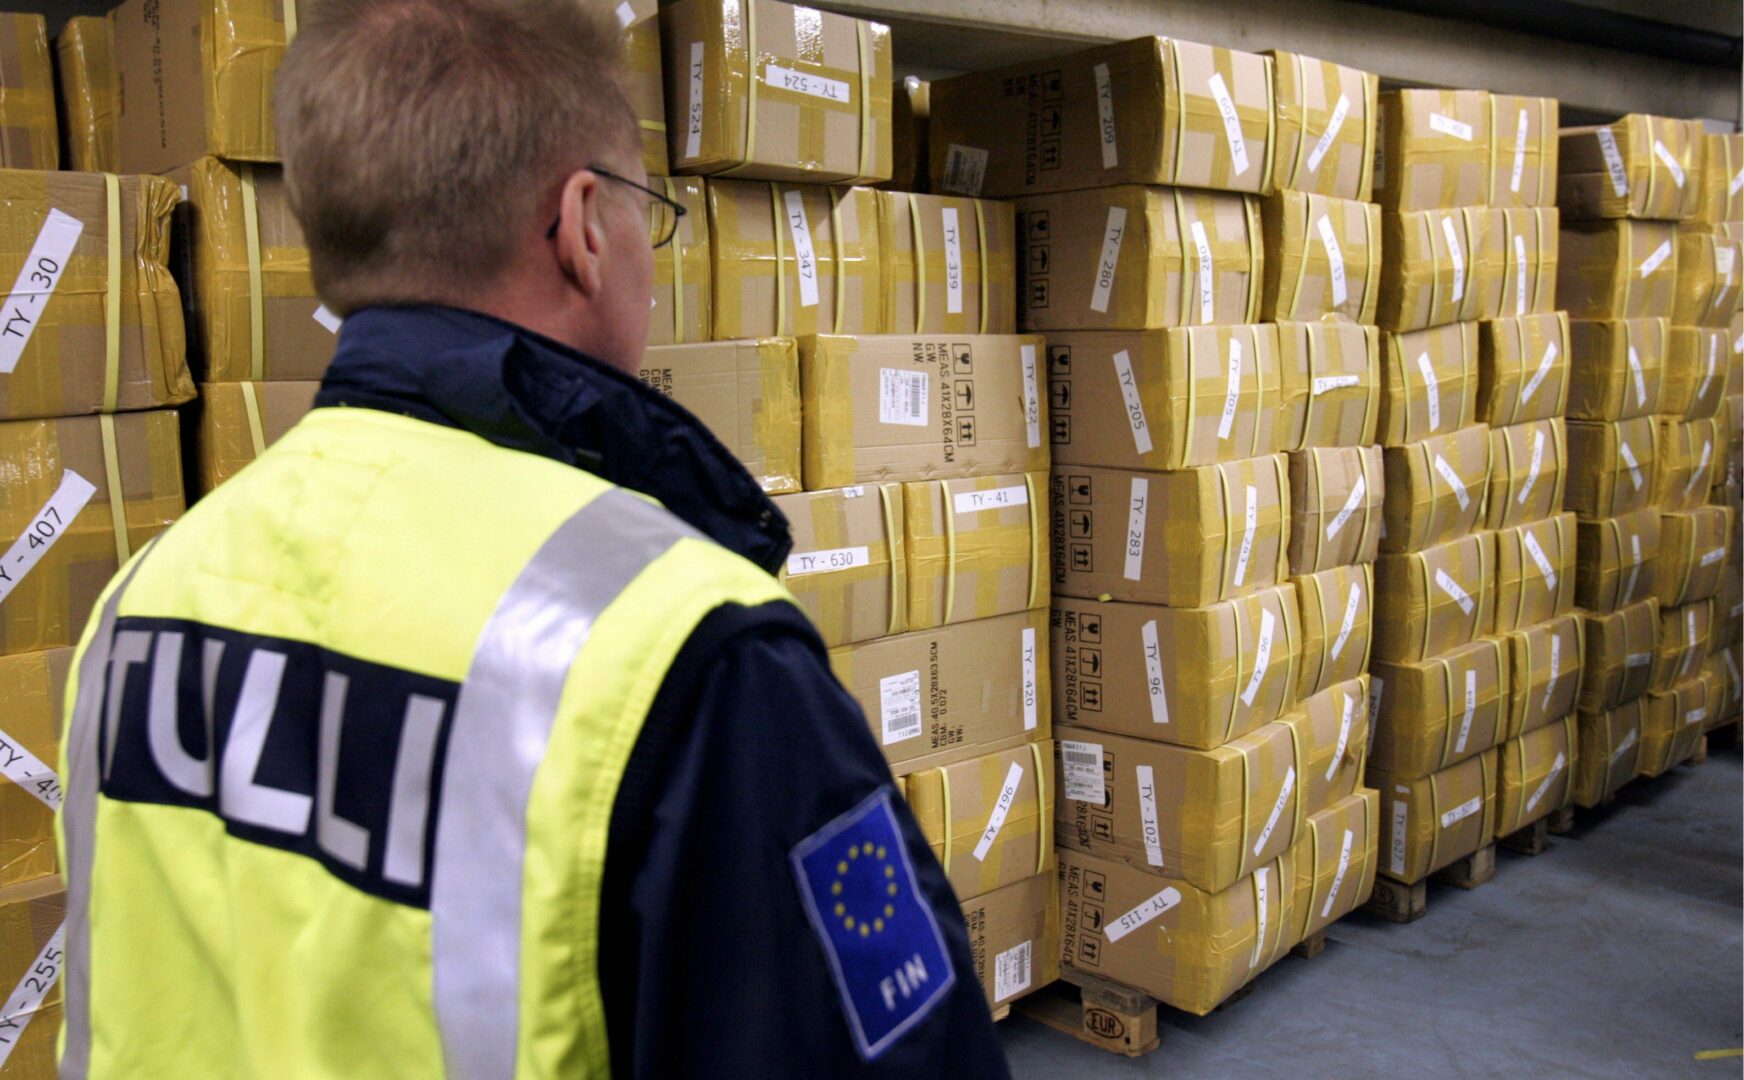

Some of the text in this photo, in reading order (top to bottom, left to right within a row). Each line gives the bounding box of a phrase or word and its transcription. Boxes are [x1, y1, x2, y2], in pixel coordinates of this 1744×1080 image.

[693, 63, 702, 81] TY
[784, 74, 808, 91] 524
[822, 86, 837, 98] TY
[1100, 84, 1110, 99] TY
[691, 103, 702, 134] 524
[1221, 98, 1236, 123] 209
[1103, 118, 1113, 144] 209
[1233, 139, 1242, 155] TY
[1602, 139, 1613, 152] TY
[791, 212, 804, 231] TY
[800, 250, 812, 279] 347
[946, 226, 955, 245] TY
[1110, 226, 1122, 245] TY
[1200, 246, 1210, 272] 280
[949, 262, 958, 290] 339
[1100, 261, 1113, 288] 280
[2, 308, 31, 338] TY
[31, 257, 59, 289] 30
[1203, 290, 1211, 304] TY
[1026, 364, 1034, 380] TY
[1232, 359, 1239, 373] TY
[1028, 397, 1038, 424] 422
[1121, 368, 1134, 387] TY
[1129, 404, 1145, 430] 205
[1226, 389, 1237, 415] 205
[940, 382, 955, 463] 41X28X64CM
[971, 493, 984, 506] TY
[996, 491, 1009, 503] 41
[1133, 496, 1144, 514] TY
[1248, 507, 1255, 519] TY
[0, 565, 12, 594] Y
[28, 506, 63, 549] 407
[1129, 530, 1142, 557] 283
[800, 556, 816, 570] TY
[830, 551, 853, 567] 630
[1024, 646, 1033, 663] TY
[1146, 643, 1158, 661] TY
[1254, 668, 1263, 682] TY
[1260, 637, 1268, 653] 96
[1025, 680, 1034, 707] 420
[1065, 645, 1079, 720] 41X28X64CM
[1150, 678, 1162, 695] 96
[106, 631, 446, 887] TULLI
[36, 779, 63, 802] 40
[1142, 785, 1152, 801] TY
[984, 825, 996, 842] TY
[999, 786, 1013, 811] 196
[1396, 813, 1405, 827] TY
[1145, 819, 1156, 844] 102
[1394, 838, 1403, 861] 627
[1154, 896, 1168, 912] TY
[1120, 910, 1142, 929] 115
[25, 948, 62, 993] 255
[879, 953, 929, 1011] FIN
[1089, 1013, 1117, 1034] EUR
